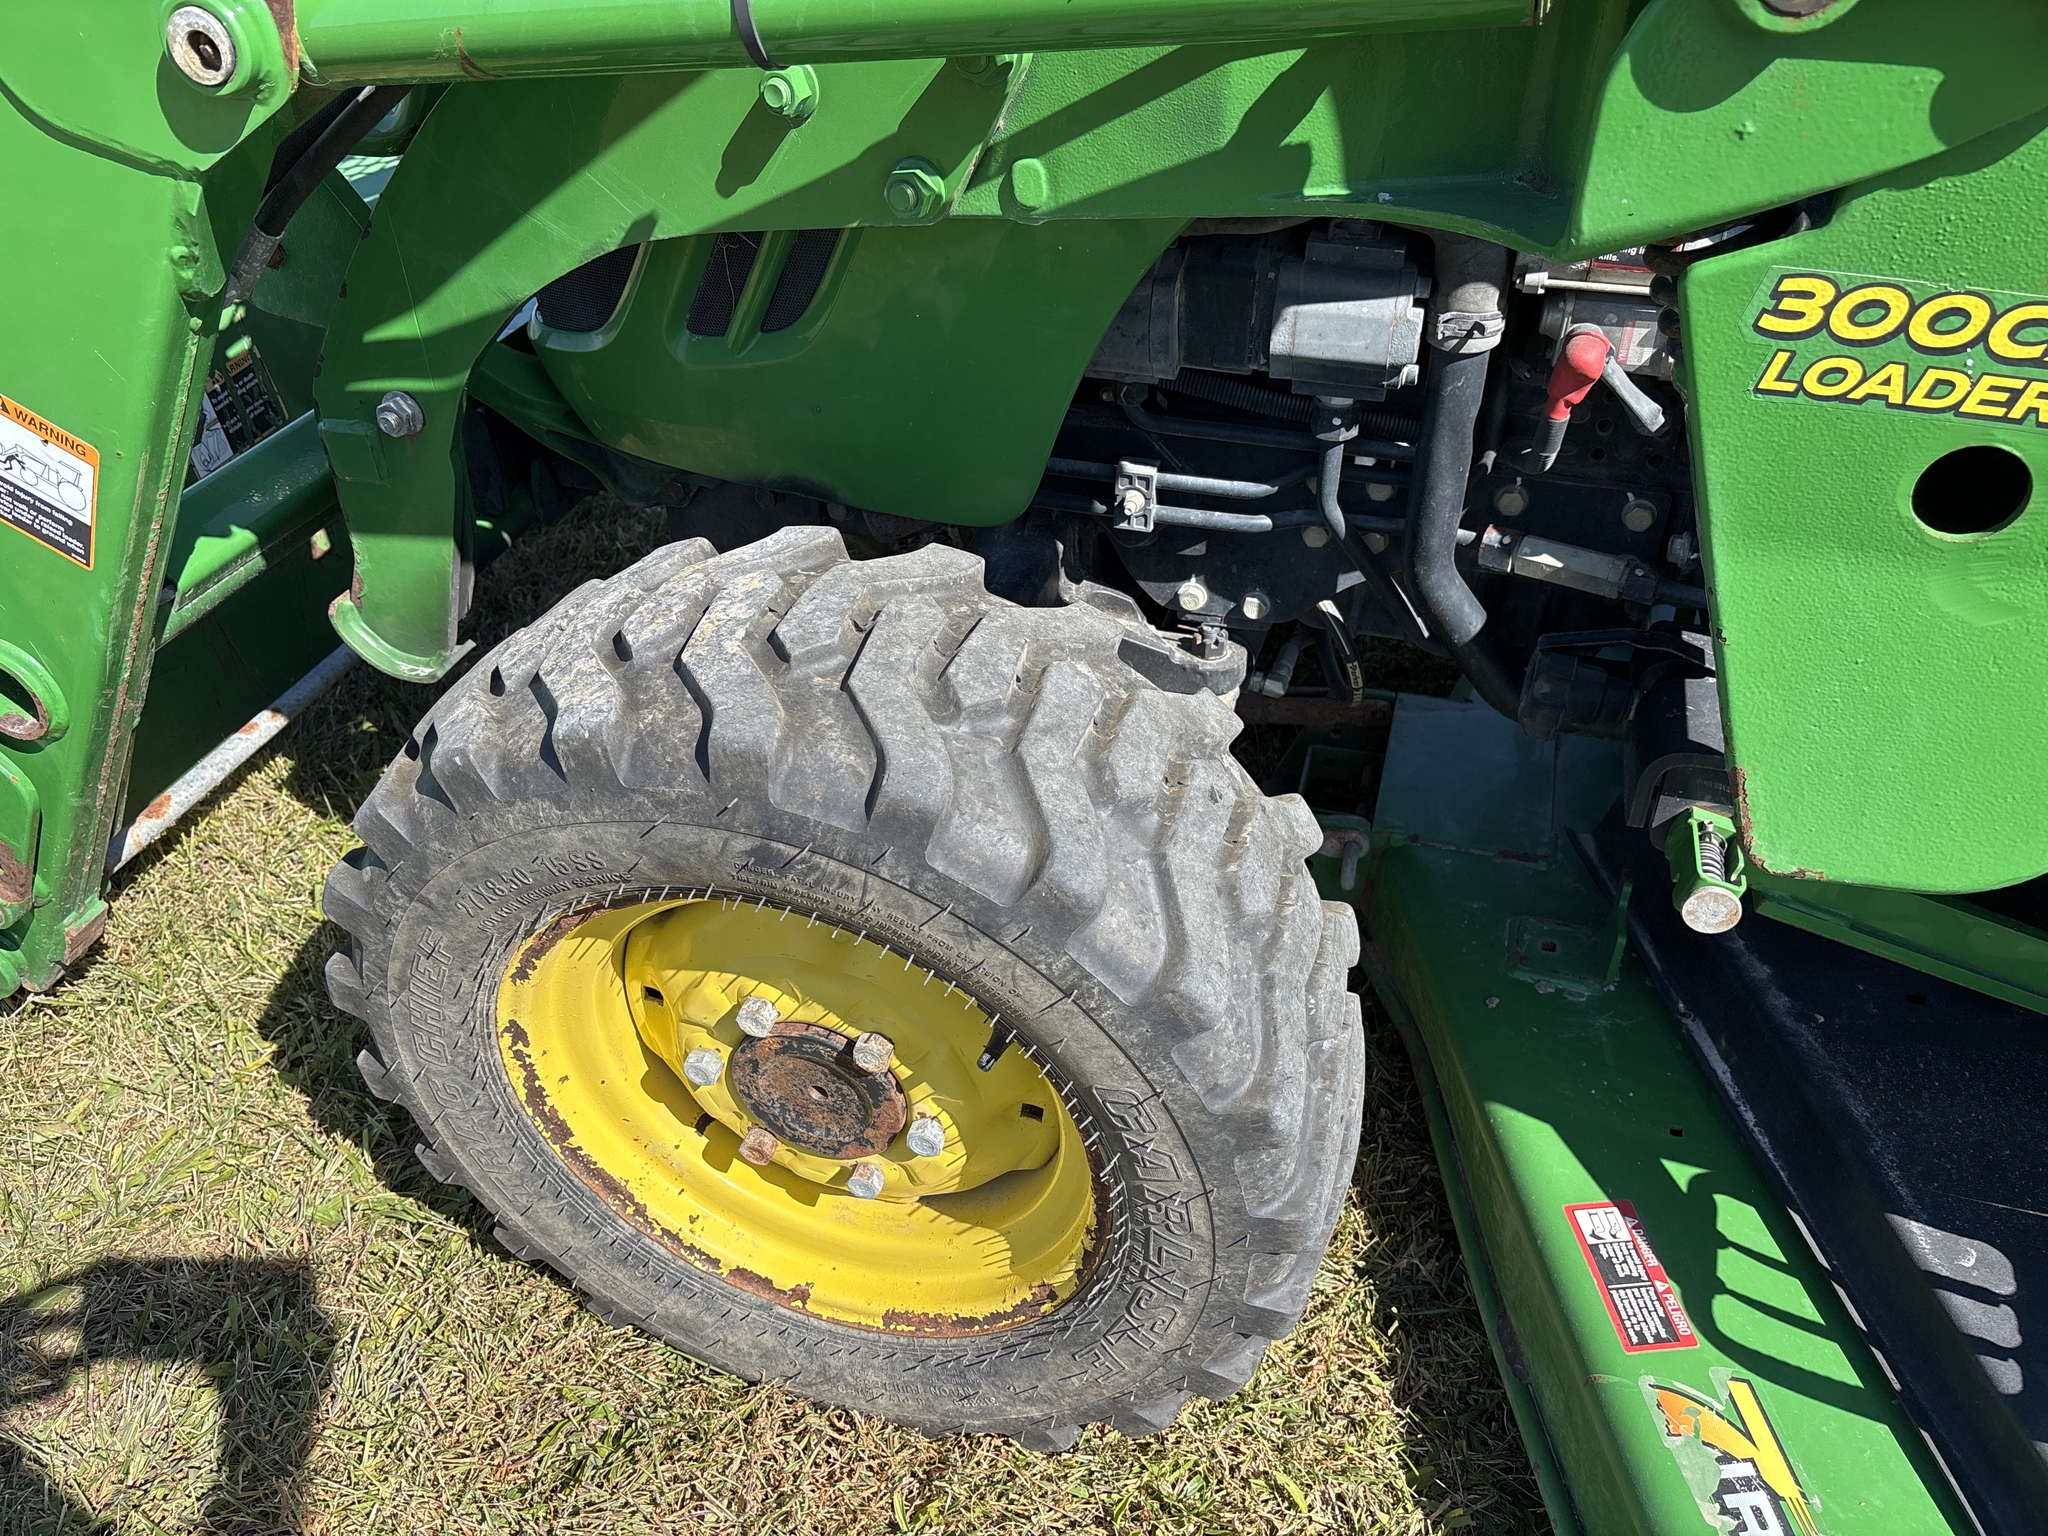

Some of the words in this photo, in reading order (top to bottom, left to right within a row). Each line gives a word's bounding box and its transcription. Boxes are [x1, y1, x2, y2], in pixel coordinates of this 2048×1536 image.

[1753, 274, 2048, 366] 300C
[13, 407, 87, 457] WARNING
[13, 500, 28, 512] walk
[38, 514, 65, 532] perform
[15, 488, 34, 504] injury
[35, 500, 51, 513] from
[52, 509, 73, 527] falling
[41, 528, 65, 544] ground
[66, 541, 84, 555] when
[515, 879, 572, 906] HIGHWAY
[571, 872, 635, 888] SERVICE
[820, 884, 857, 903] INJURY
[886, 913, 923, 934] RESULT
[926, 933, 955, 951] FROM
[408, 926, 453, 1067] CHIEF
[428, 1077, 534, 1204] TRAC
[1070, 1085, 1194, 1384] CARLISLE
[1631, 1228, 1659, 1268] DANGER
[1661, 1293, 1692, 1336] PELIGRO
